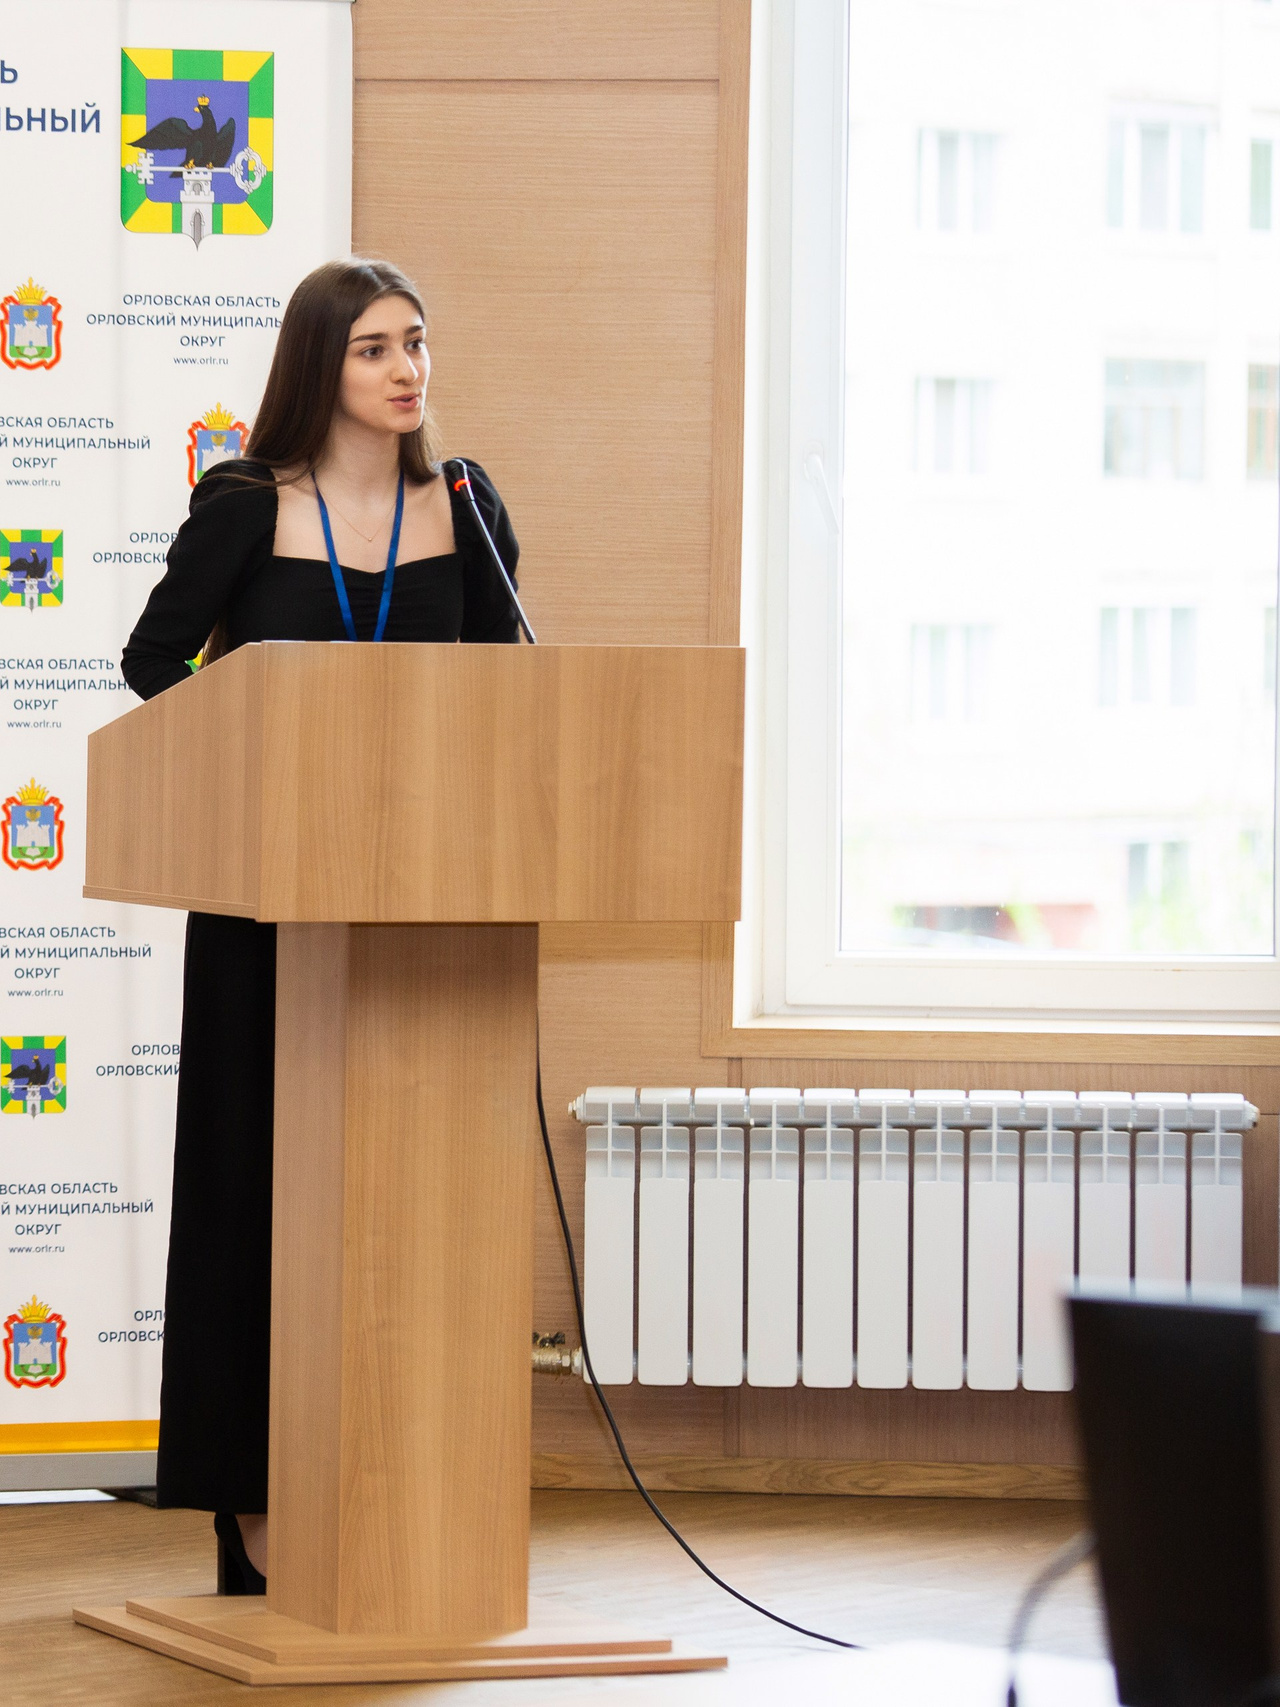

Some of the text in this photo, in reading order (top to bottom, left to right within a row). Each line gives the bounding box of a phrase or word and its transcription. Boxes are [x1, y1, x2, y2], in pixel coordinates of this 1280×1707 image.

[123, 294, 280, 308] ОРЛОВСКАЯ ОБЛАСТЬ
[87, 313, 281, 329] ОРЛОВСКИЙ МУНИЦИПАЛЬ
[180, 336, 225, 347] ОКРУГ
[173, 356, 228, 364] www.orlr.ru
[47, 417, 114, 428] ОБЛАСТЬ
[13, 436, 150, 450] МУНИЦИПАЛЬНЫЙ
[12, 457, 57, 468] ОКРУГ
[6, 478, 60, 486] www.orlr.ru
[129, 532, 178, 543] ОРЛОВ
[93, 552, 166, 563] ОРЛОВСК
[48, 659, 114, 670] ОБЛАСТЬ
[14, 679, 131, 692] МУНИЦИПАЛЬН
[14, 699, 58, 710] ОКРУГ
[7, 720, 61, 728] www.orlr.ru
[50, 927, 115, 938] ОБЛАСТЬ
[15, 944, 151, 960] МУНИЦИПАЛЬНЫЙ
[14, 968, 60, 979] ОКРУГ
[8, 988, 63, 996] www.orlr.ru
[132, 1044, 180, 1055] ОРЛОВ
[51, 1182, 118, 1194] ОБЛАСТЬ
[16, 1199, 153, 1216] МУНИЦИПАЛЬНЫЙ
[15, 1224, 61, 1235] ОКРУГ
[9, 1245, 65, 1253] www.orlr.ru
[98, 1330, 164, 1342] ОРЛОВСК
